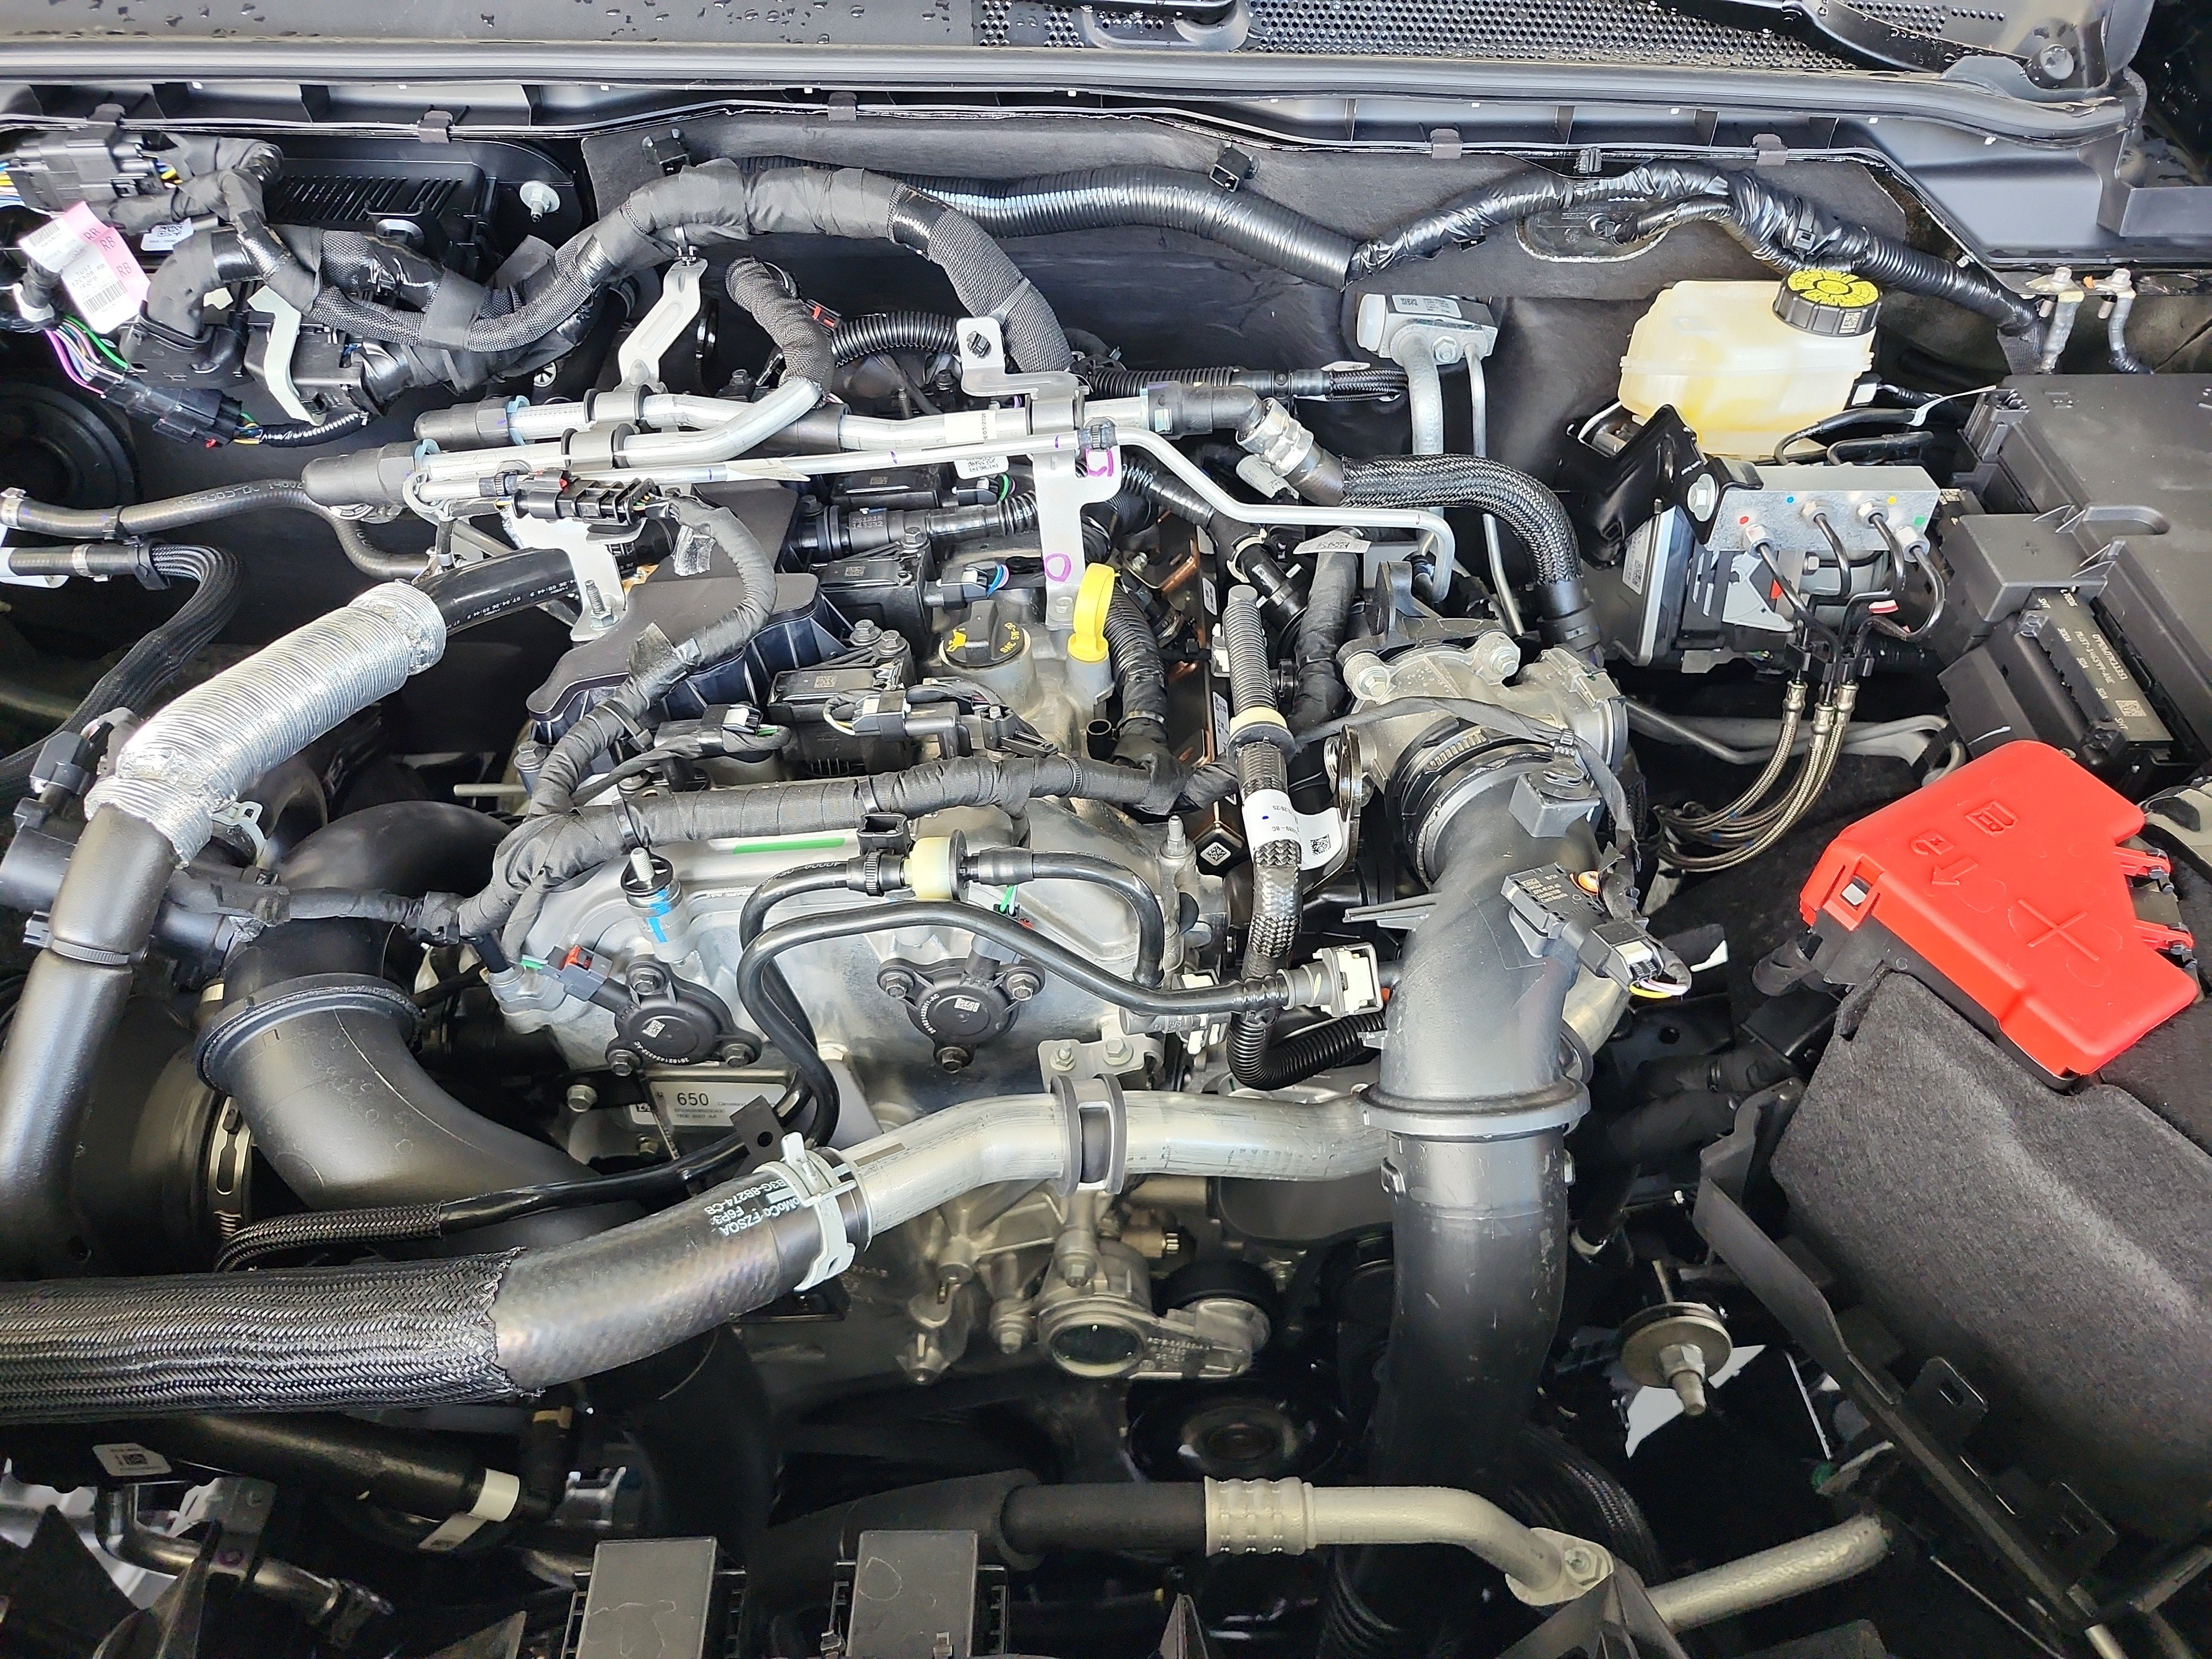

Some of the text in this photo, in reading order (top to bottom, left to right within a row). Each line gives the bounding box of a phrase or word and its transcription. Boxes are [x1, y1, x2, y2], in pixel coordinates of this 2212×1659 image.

[100, 236, 115, 251] RB
[116, 262, 132, 278] RB
[678, 1092, 709, 1105] 650
[705, 1179, 787, 1214] B3G-8B274-CB
[763, 1198, 800, 1217] oMoCo
